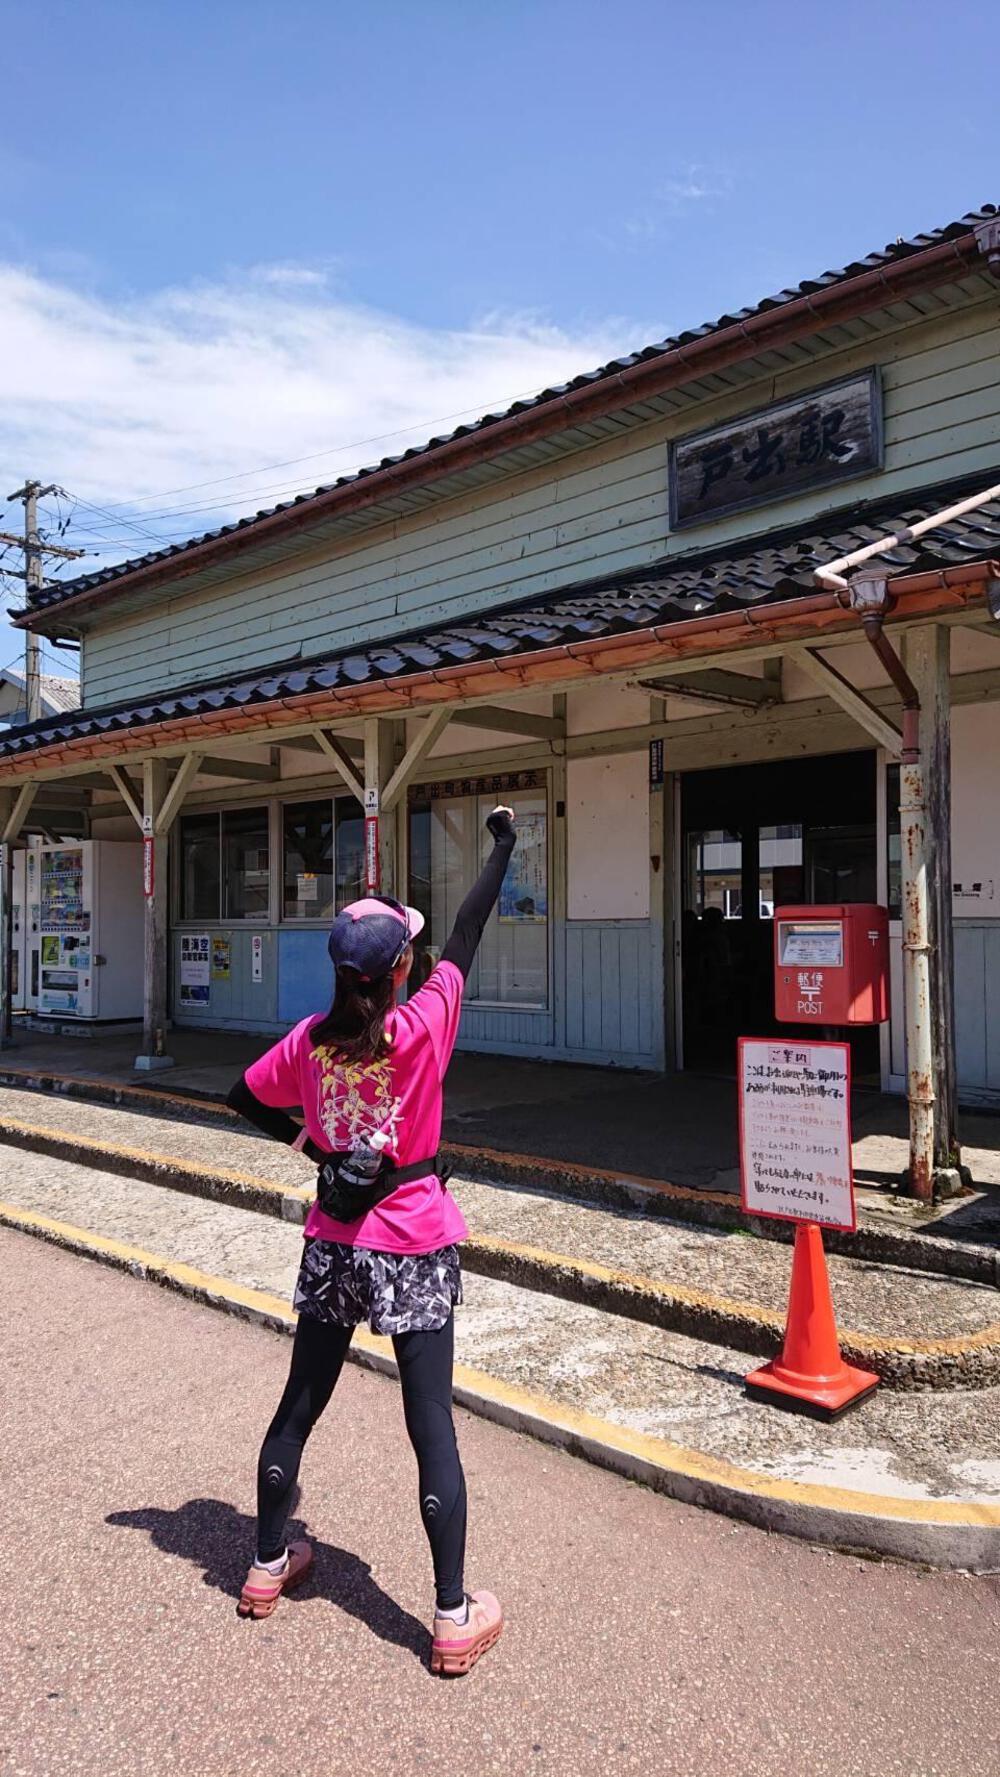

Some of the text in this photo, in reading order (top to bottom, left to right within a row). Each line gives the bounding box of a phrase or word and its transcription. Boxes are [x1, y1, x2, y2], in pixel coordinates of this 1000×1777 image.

[697, 404, 854, 499] 戸出駅
[182, 938, 208, 951] 陸海空
[797, 972, 824, 988] 郵便
[797, 1000, 823, 1014] POST
[772, 1048, 806, 1063] ご案内
